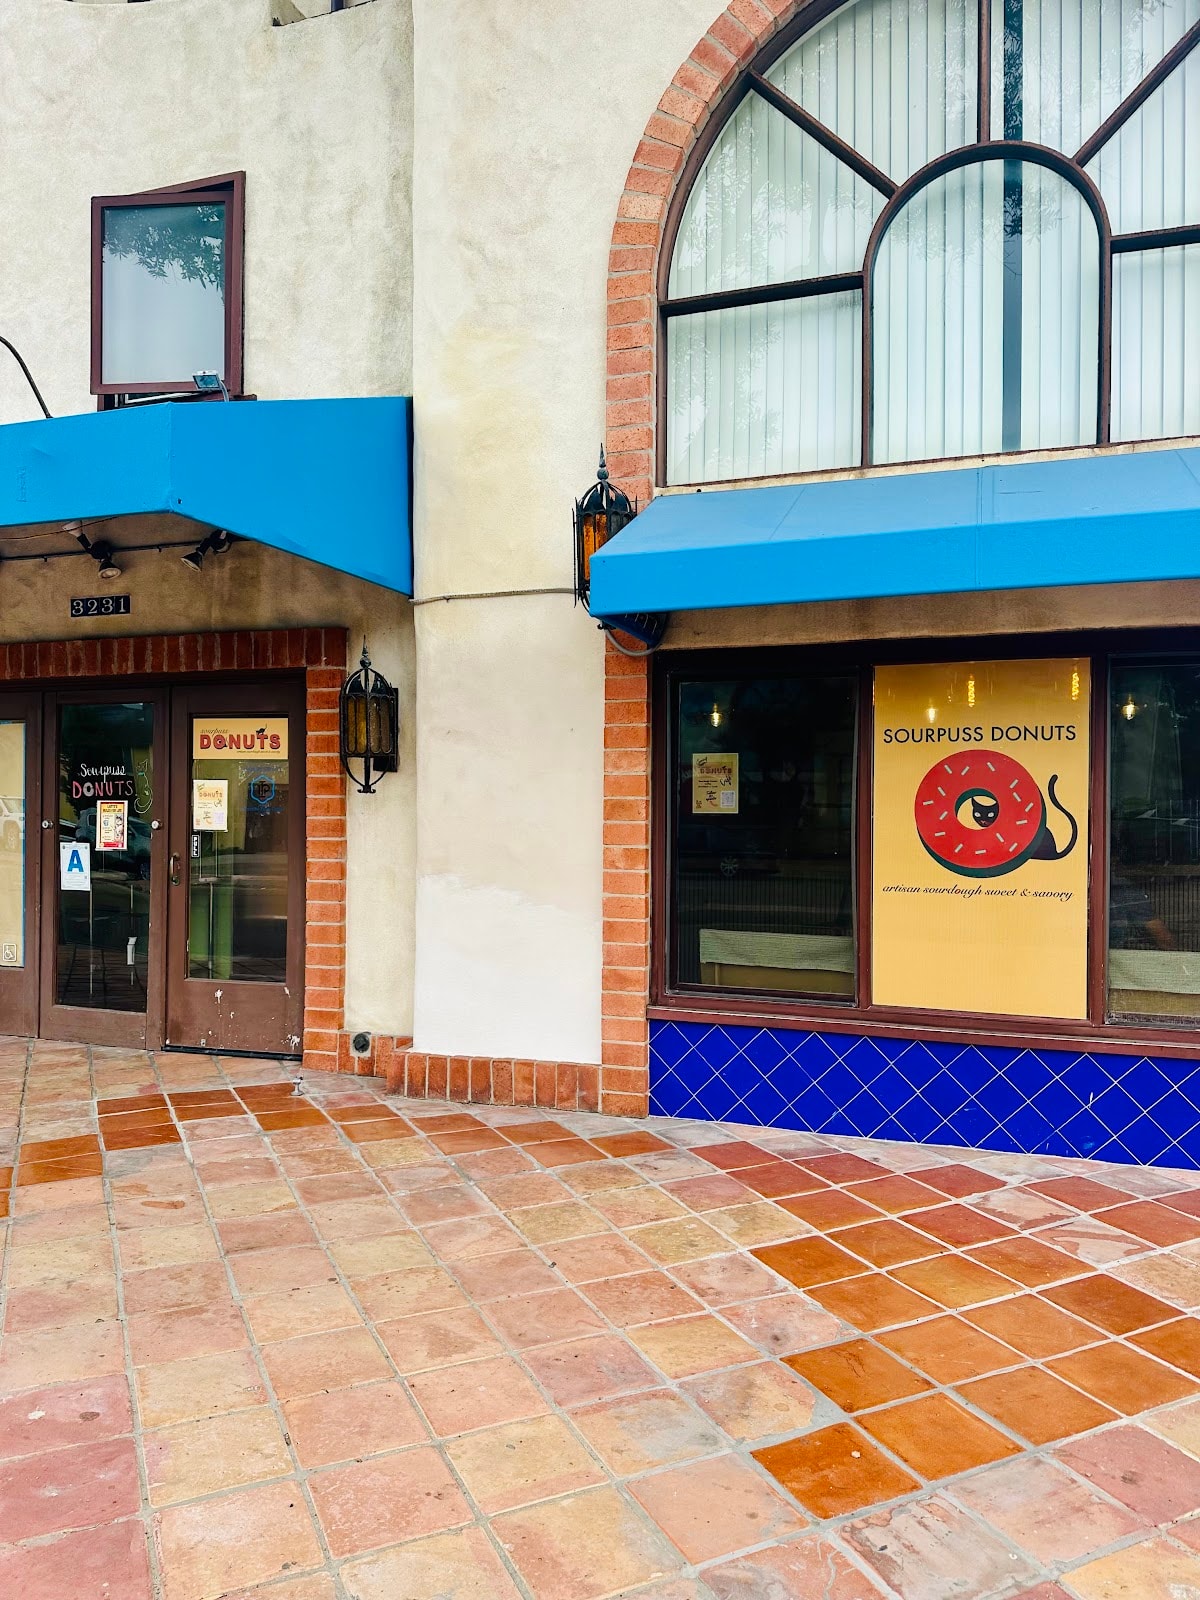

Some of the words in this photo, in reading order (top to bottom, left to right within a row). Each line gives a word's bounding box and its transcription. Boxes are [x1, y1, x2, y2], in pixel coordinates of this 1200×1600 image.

[72, 597, 126, 615] 3231
[200, 733, 281, 750] DONUTS
[883, 726, 984, 744] SOURPUSS
[991, 725, 1076, 742] DONUTS
[67, 849, 84, 873] A
[882, 884, 921, 893] artisan
[923, 884, 982, 898] sourdough
[985, 888, 1017, 896] sweet
[1020, 888, 1031, 897] &
[1032, 890, 1074, 902] savory
